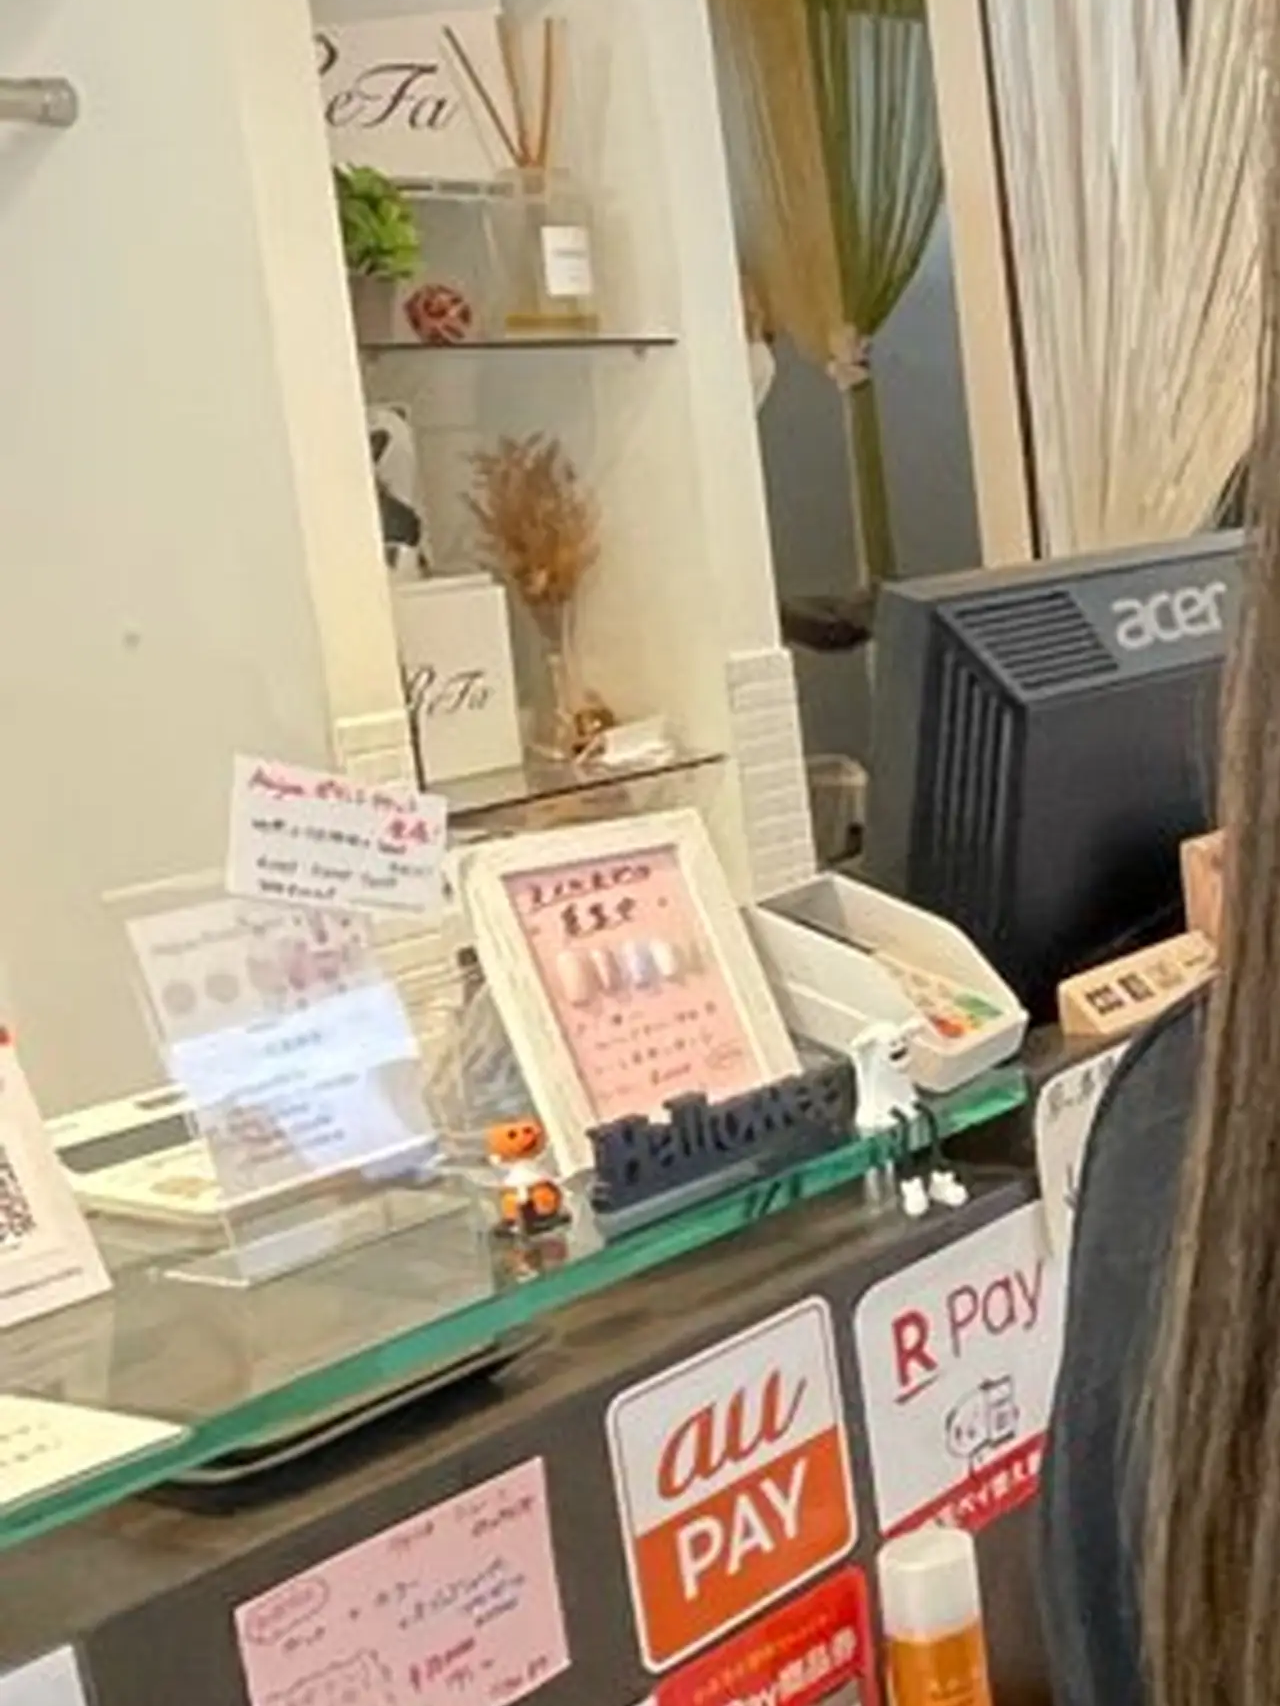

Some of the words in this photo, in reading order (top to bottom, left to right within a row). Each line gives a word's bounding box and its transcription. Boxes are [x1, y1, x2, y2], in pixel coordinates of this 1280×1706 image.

[1110, 581, 1229, 653] acer
[945, 1259, 1044, 1358] Pay
[657, 1369, 808, 1501] au
[675, 1456, 809, 1605] PAY
